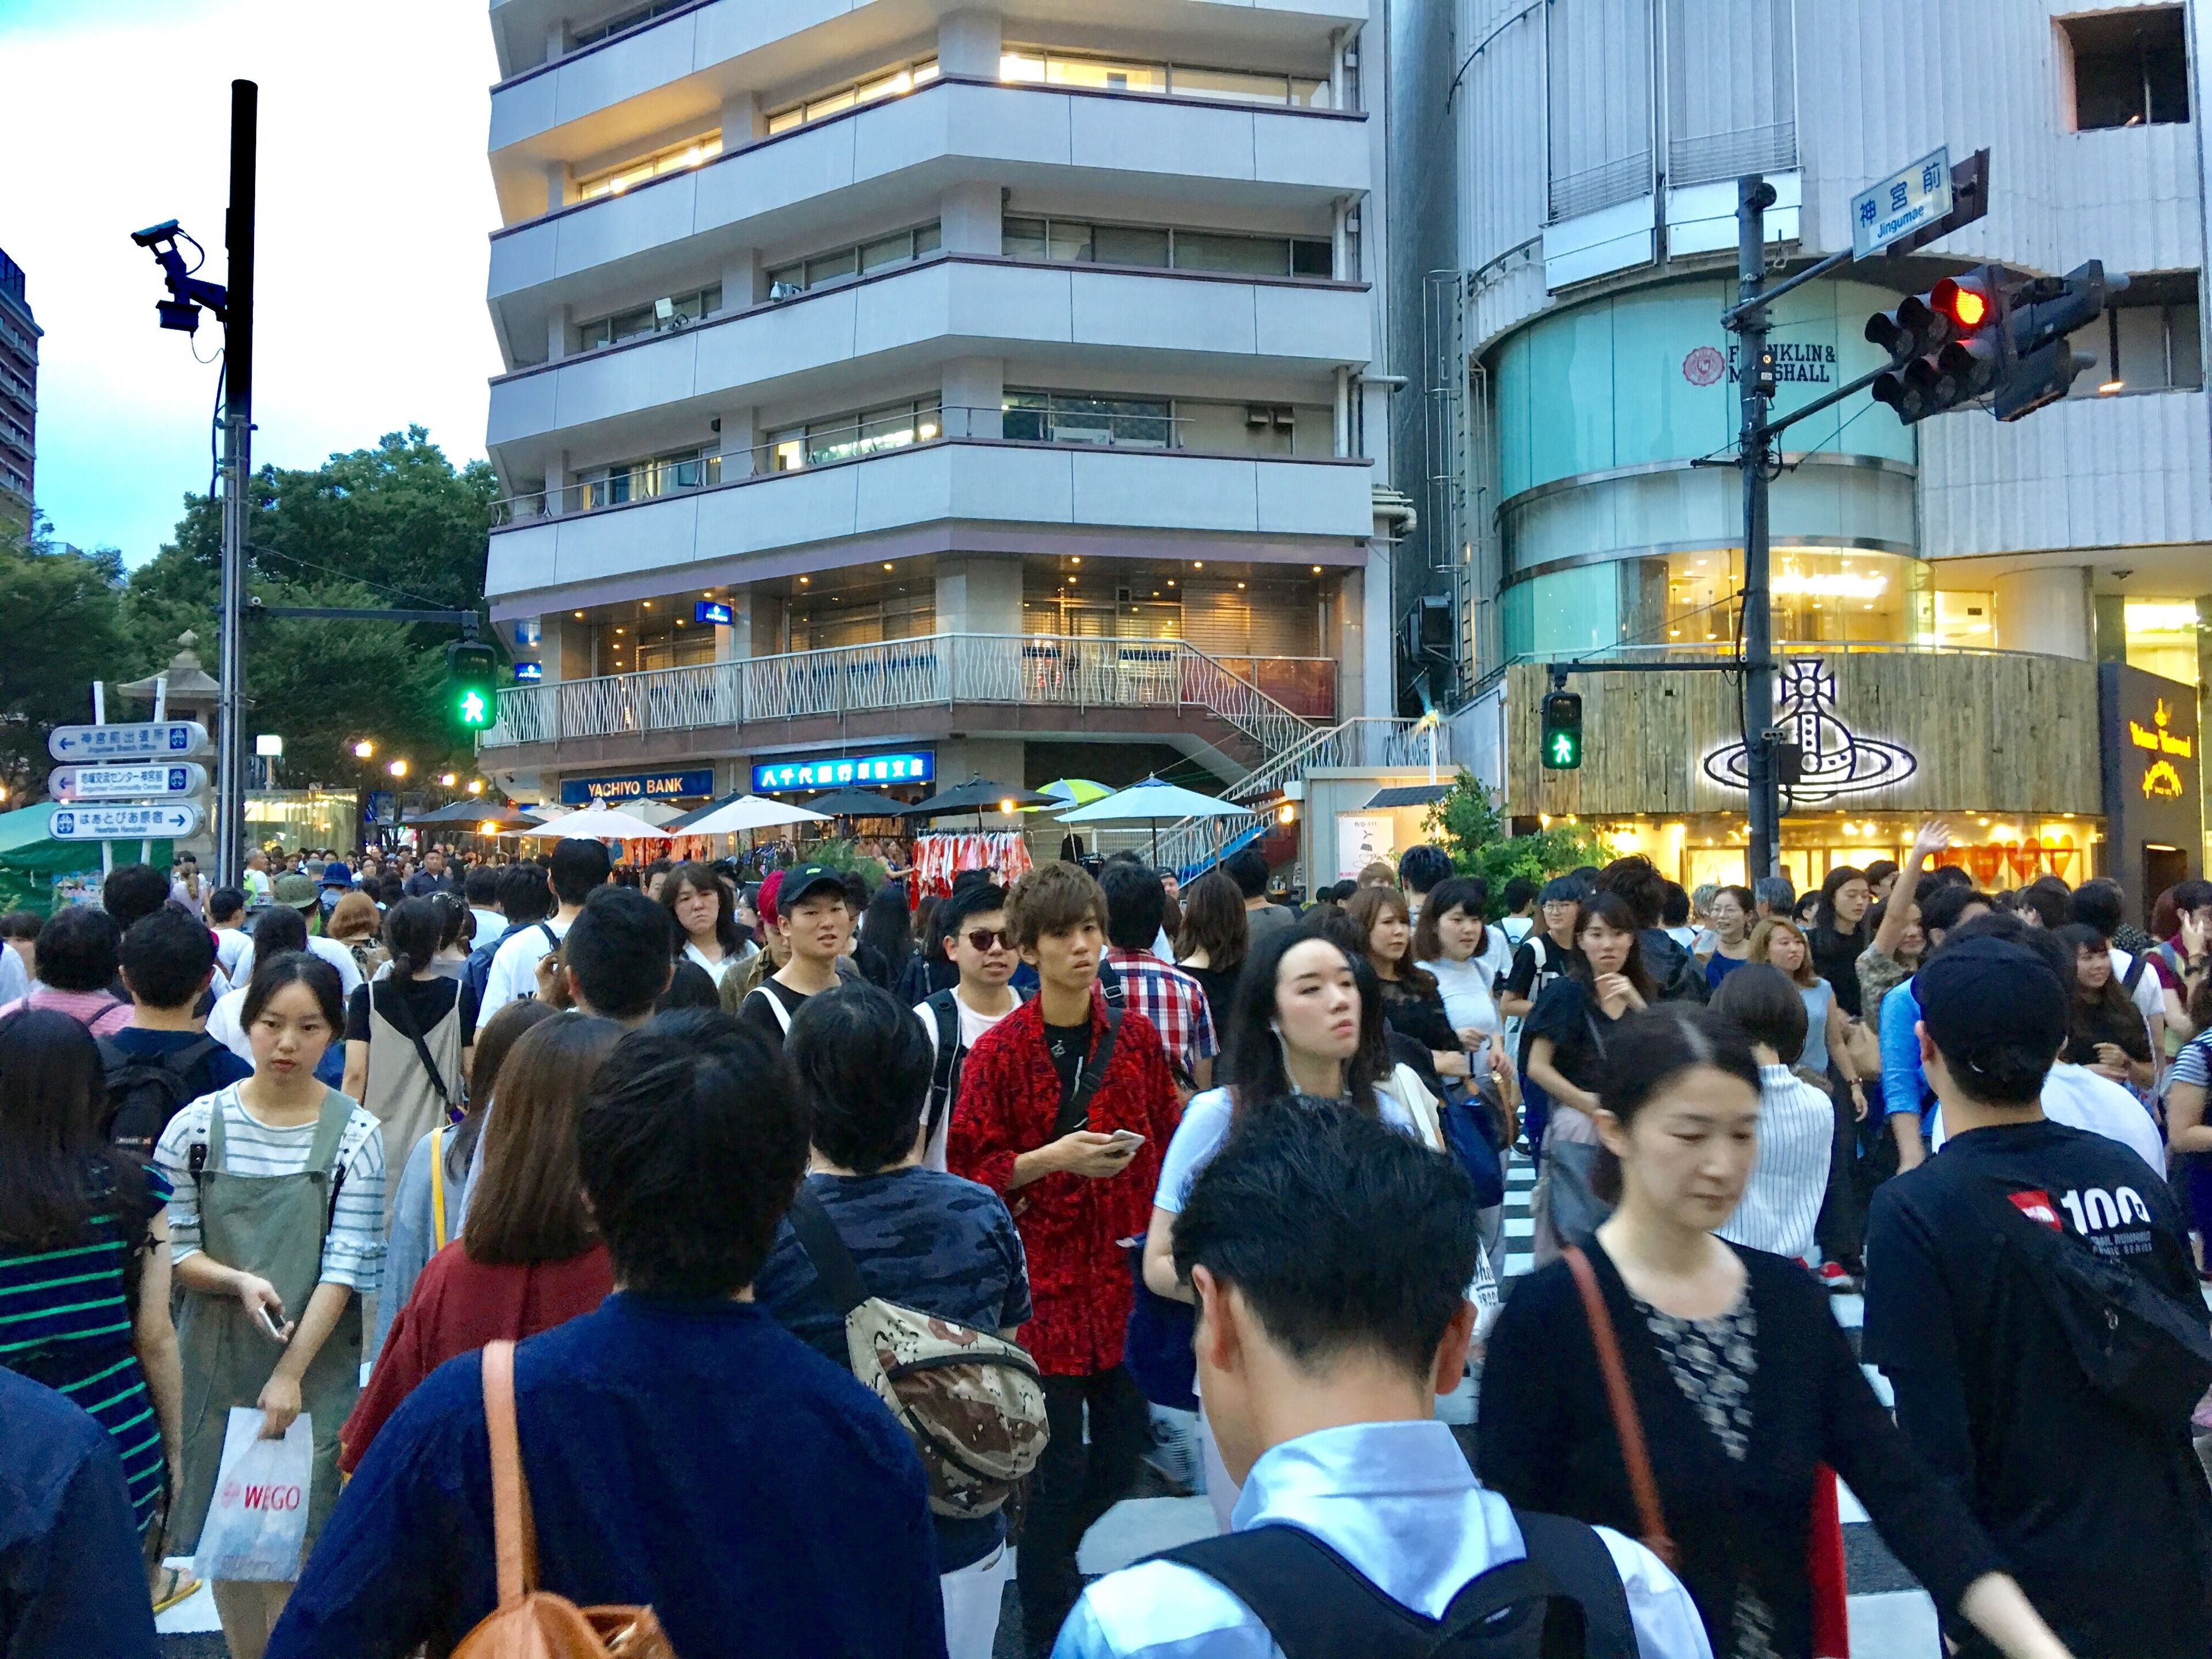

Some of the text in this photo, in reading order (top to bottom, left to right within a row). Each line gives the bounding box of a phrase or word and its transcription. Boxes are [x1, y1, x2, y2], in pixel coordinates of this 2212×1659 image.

[1859, 161, 1941, 228] 神宮前
[1877, 205, 1925, 238] Jingumae
[1729, 344, 1823, 363] FNKLIN
[1729, 363, 1830, 383] MSHALL
[588, 778, 683, 797] YACHIYO BANK
[244, 1484, 301, 1512] WEGO
